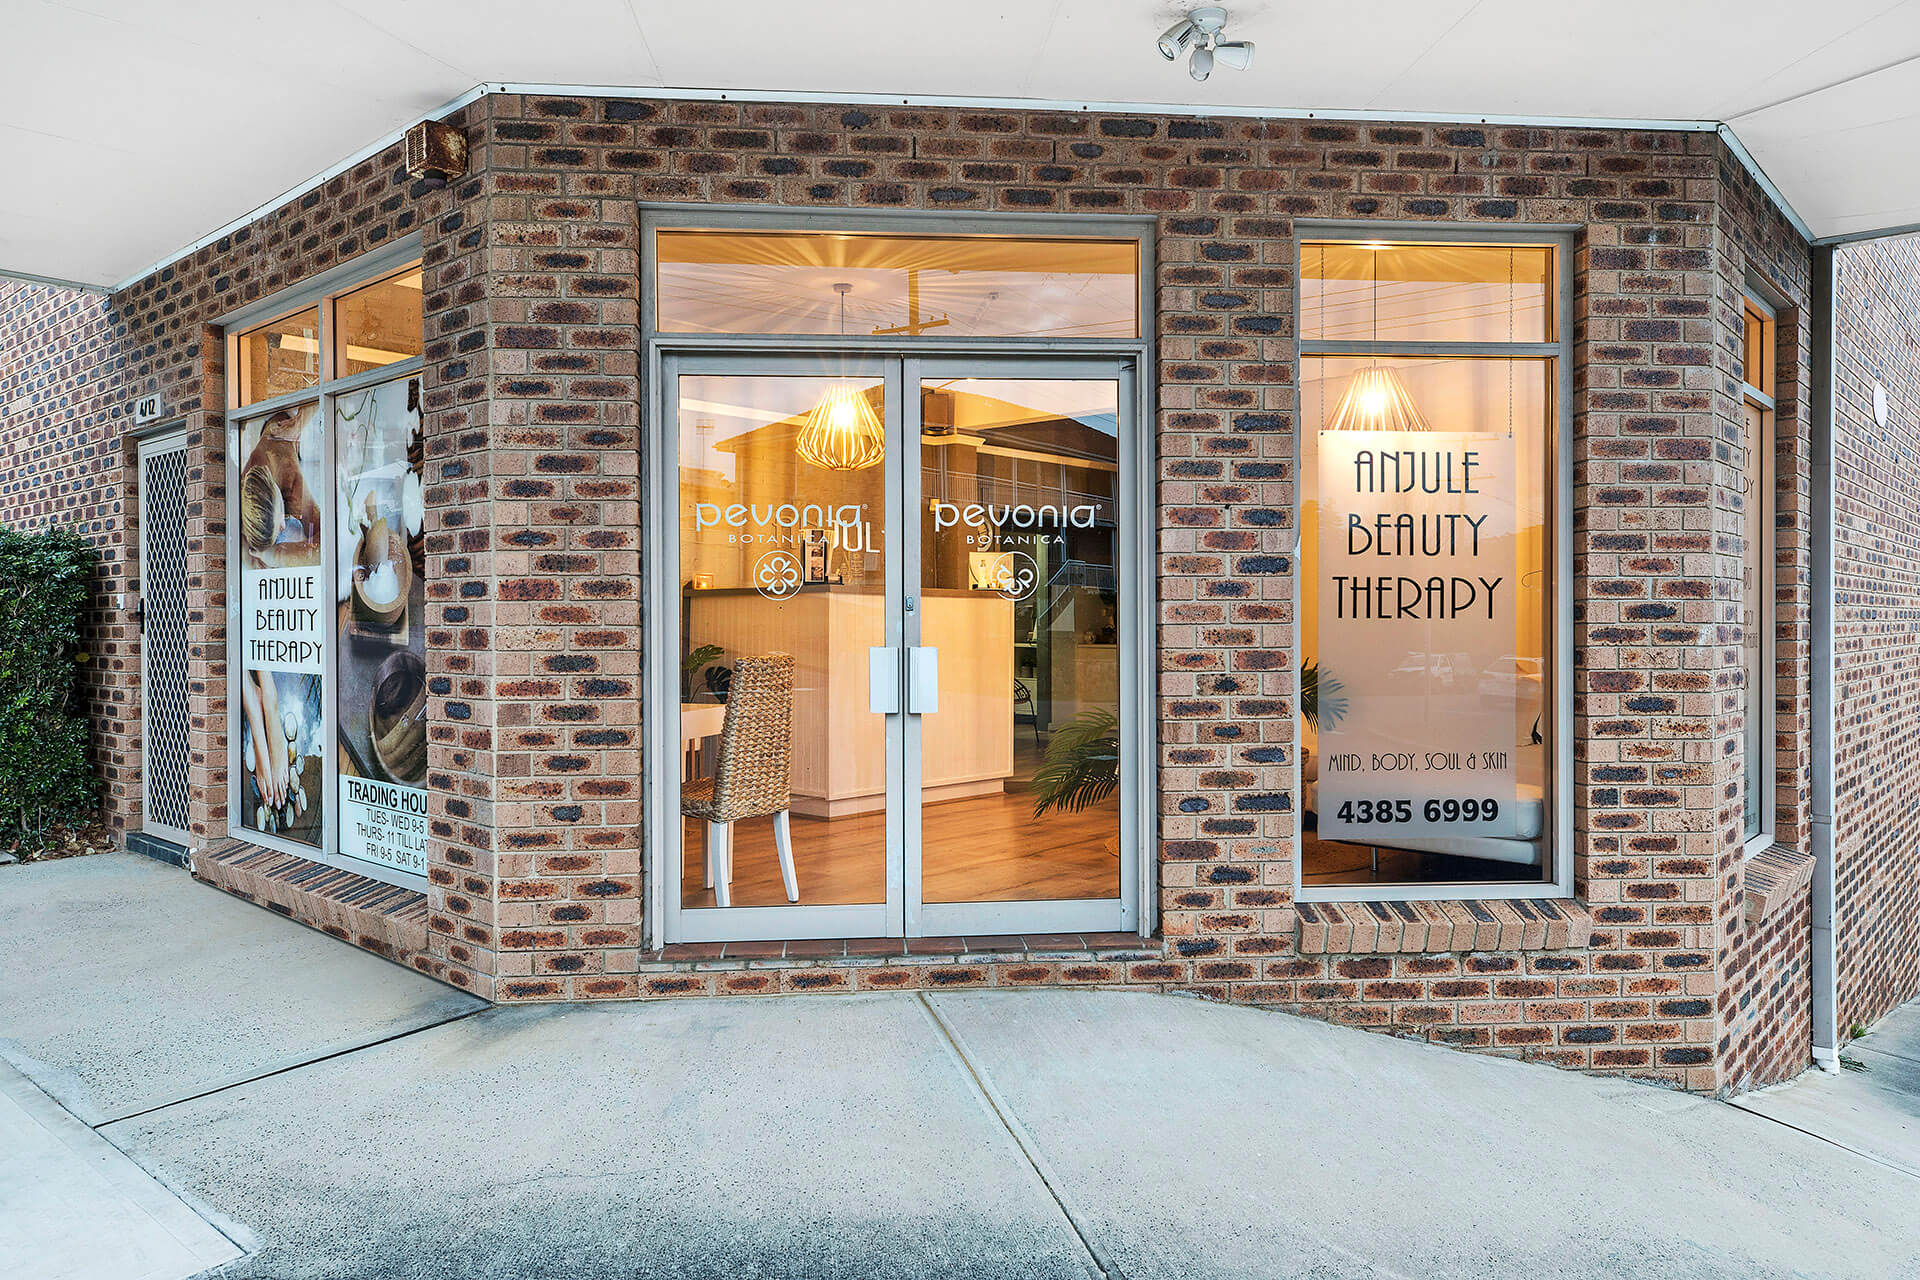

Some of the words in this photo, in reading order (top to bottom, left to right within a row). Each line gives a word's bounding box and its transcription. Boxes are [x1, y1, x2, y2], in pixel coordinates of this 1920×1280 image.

[1354, 450, 1480, 494] ANJULE
[728, 534, 830, 544] BOTANICA
[966, 535, 1065, 545] BOTANICA
[1348, 513, 1488, 556] BEAUTY
[258, 576, 314, 600] ANJULE
[1332, 576, 1503, 619] THERAPY
[256, 609, 318, 631] BEAUTY
[249, 639, 323, 664] THERAPY
[1328, 753, 1366, 772] MIND,
[1372, 753, 1419, 772] BODY,
[1424, 752, 1461, 771] SOUL
[1466, 752, 1476, 770] &
[1482, 752, 1507, 770] SKIN
[347, 780, 398, 808] TRADING
[1337, 799, 1412, 823] 4385
[1423, 798, 1499, 822] 6999
[391, 813, 410, 831] WED
[411, 818, 424, 834] 9-5
[366, 842, 379, 858] FRI
[380, 846, 392, 861] 9-5
[396, 850, 411, 866] SAT
[397, 832, 413, 850] TILL
[414, 836, 428, 852] LA
